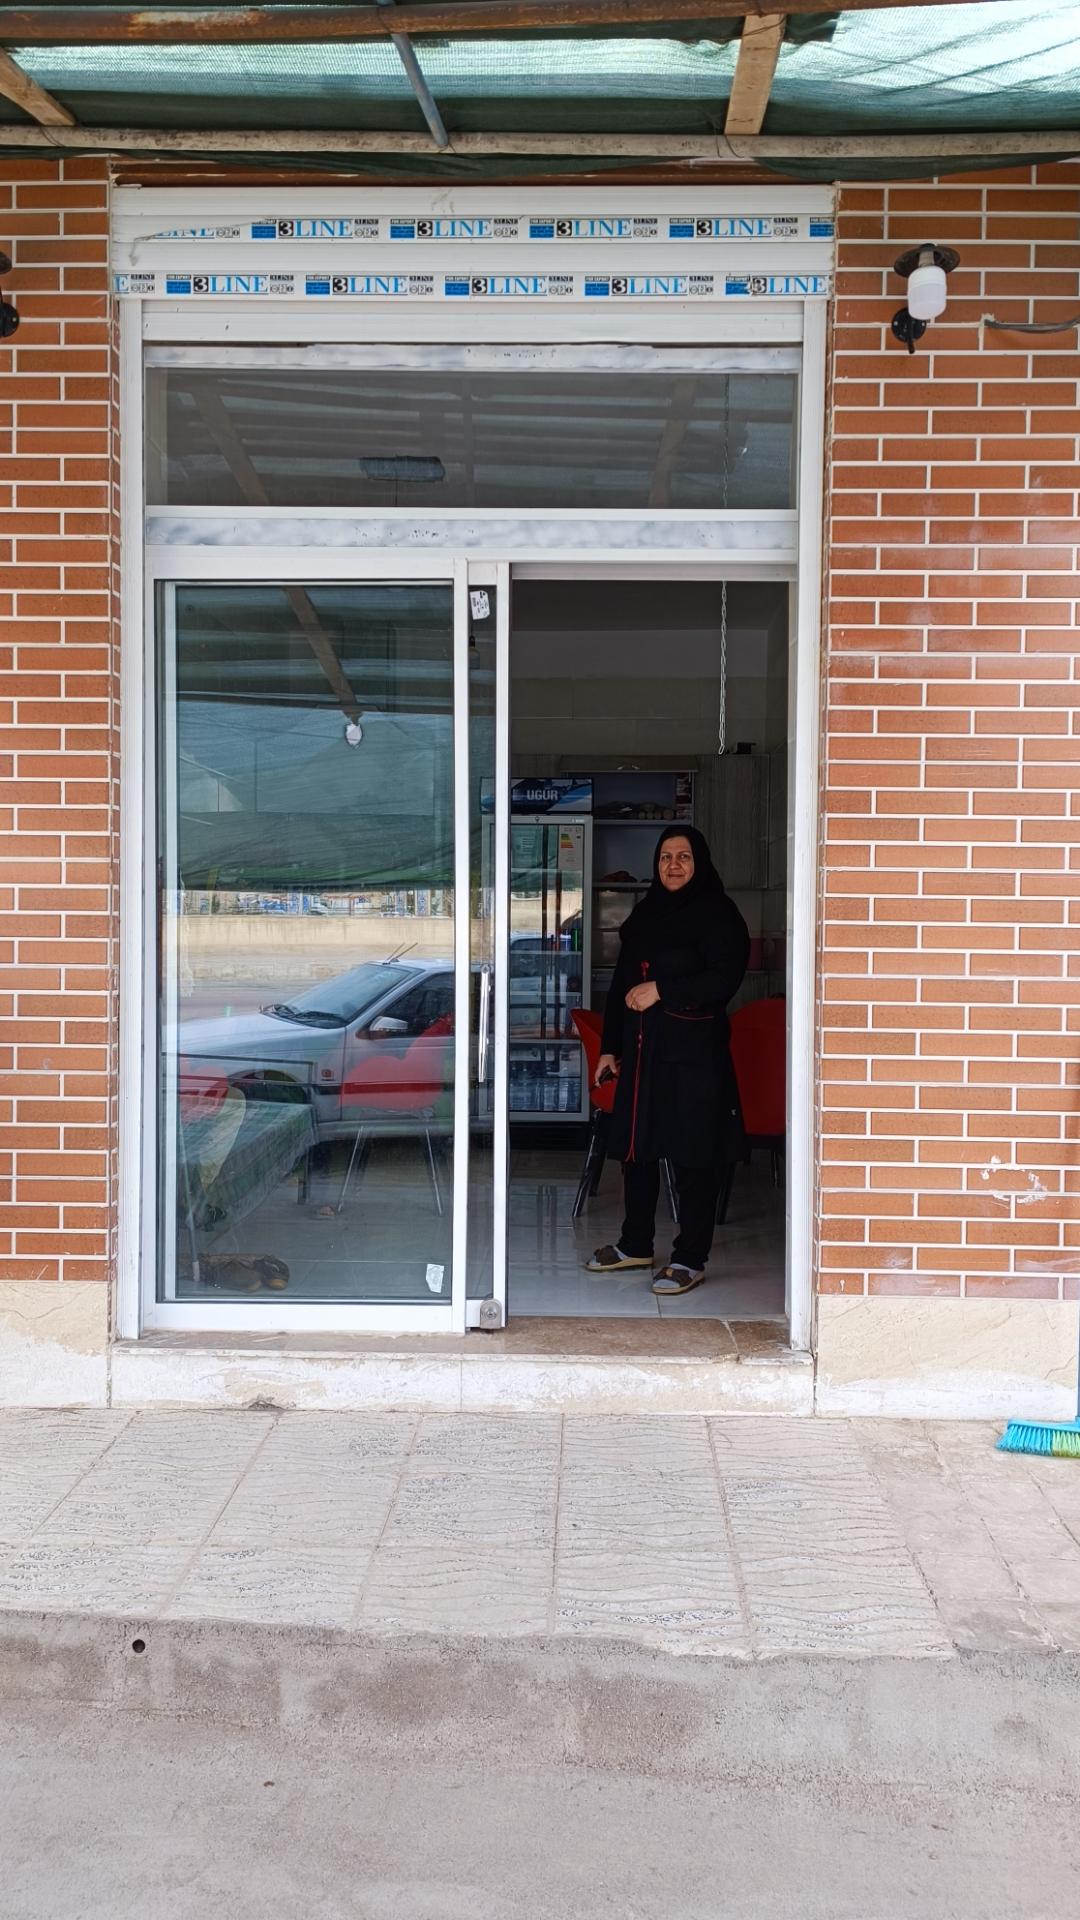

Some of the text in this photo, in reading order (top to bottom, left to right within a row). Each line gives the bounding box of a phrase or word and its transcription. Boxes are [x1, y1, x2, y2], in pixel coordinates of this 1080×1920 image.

[279, 220, 352, 237] 3LINE
[417, 220, 492, 237] 3LINE
[556, 219, 631, 236] 3LINE
[696, 219, 771, 236] 3LINE
[194, 276, 268, 293] 3LINE
[332, 276, 408, 294] 3LINE
[471, 277, 547, 294] 3LINE
[612, 277, 688, 294] 3LINE
[752, 276, 828, 294] 3LINE
